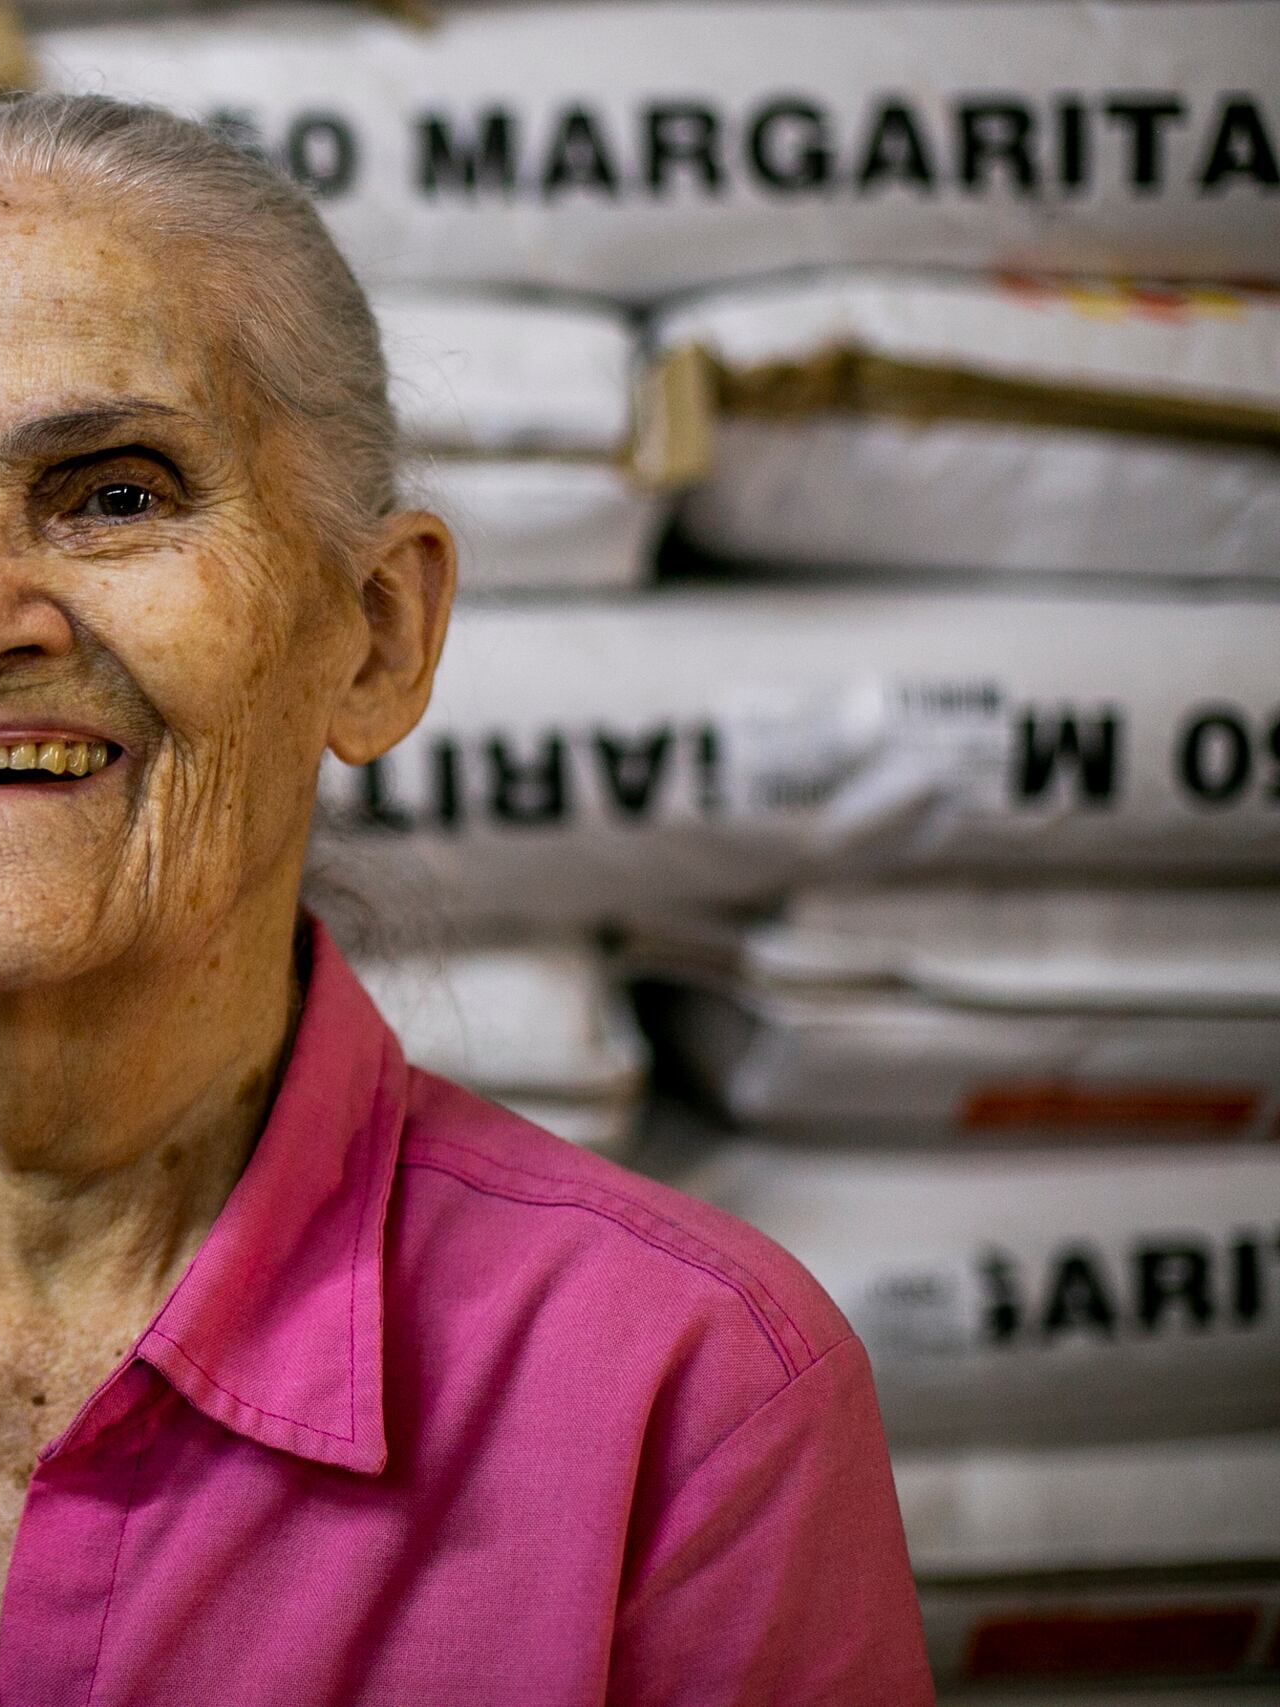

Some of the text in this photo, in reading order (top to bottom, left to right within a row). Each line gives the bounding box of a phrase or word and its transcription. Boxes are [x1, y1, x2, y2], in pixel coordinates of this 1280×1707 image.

[418, 95, 1280, 197] MARGARITA
[1176, 705, 1280, 805] O
[980, 1232, 1280, 1342] ARI
